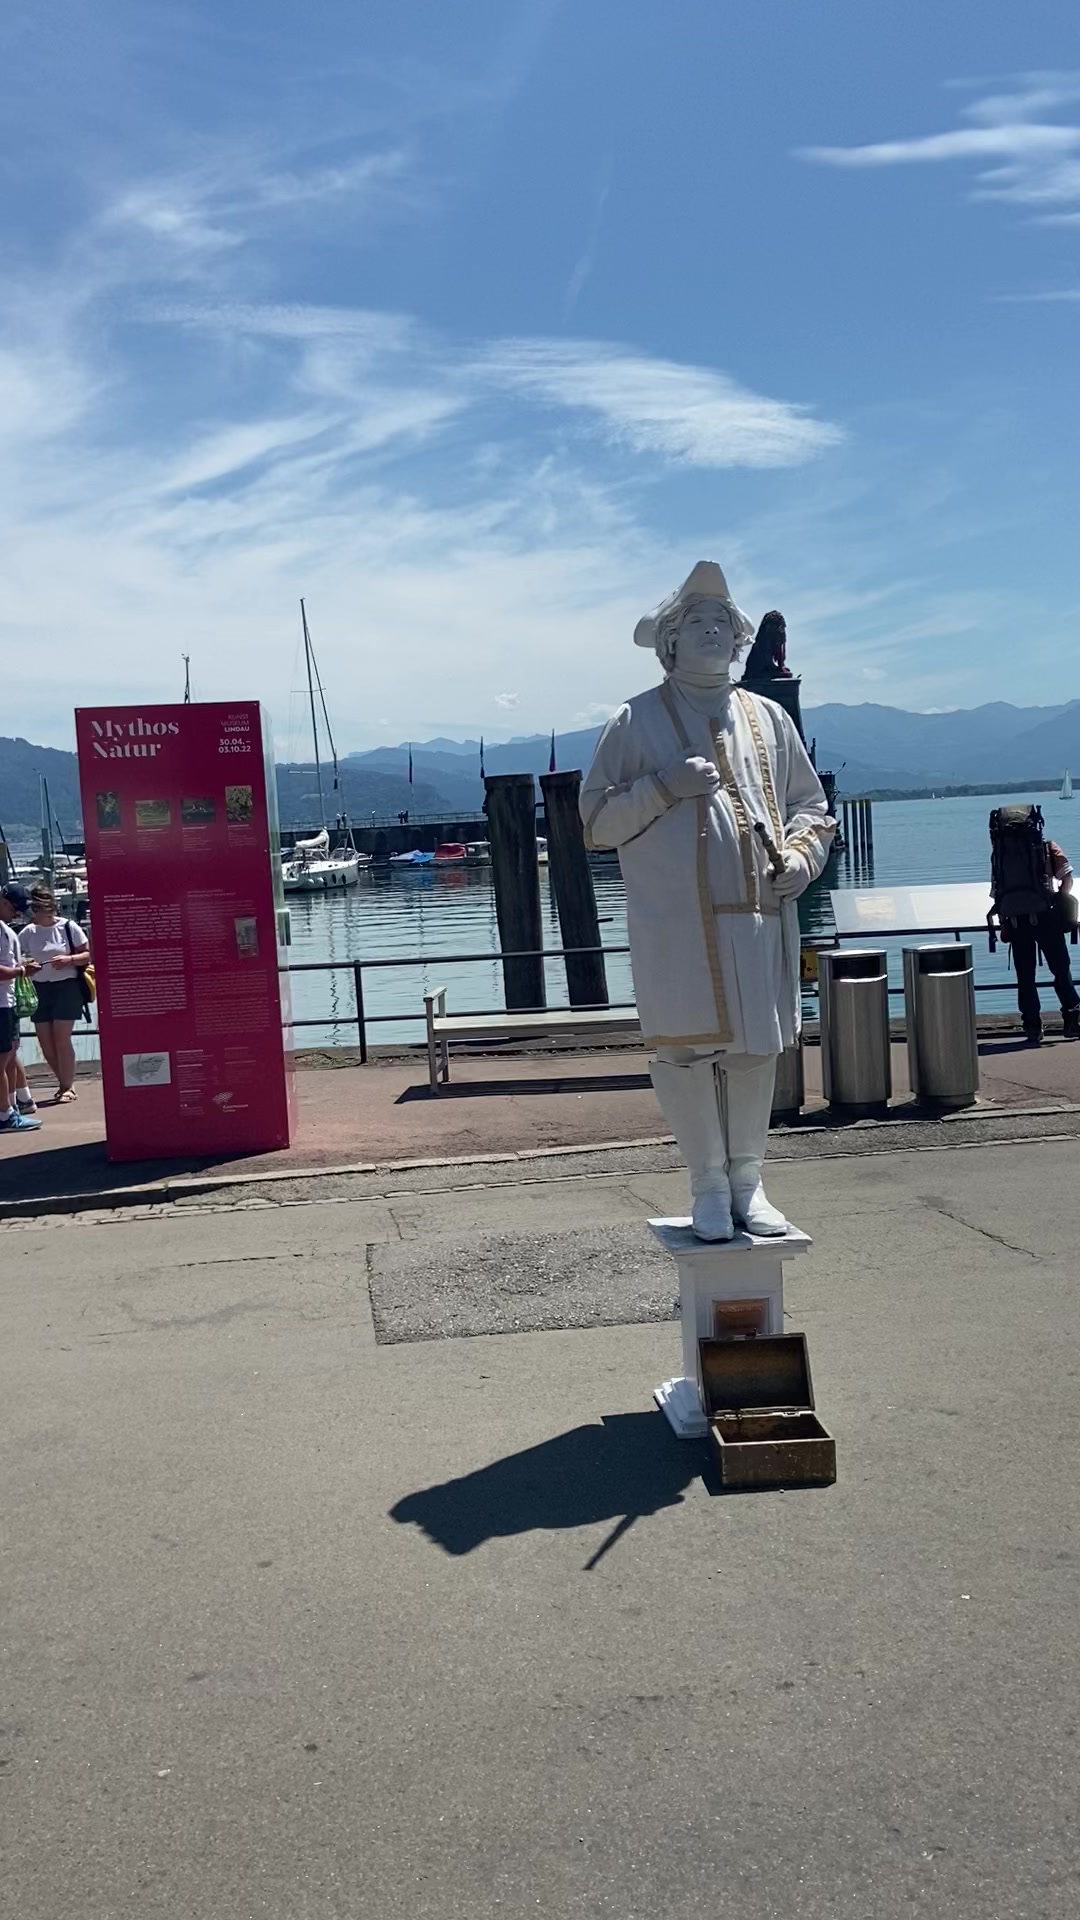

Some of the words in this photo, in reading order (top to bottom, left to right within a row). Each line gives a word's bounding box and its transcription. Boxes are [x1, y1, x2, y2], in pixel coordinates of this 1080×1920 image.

[91, 717, 180, 741] Mythos
[92, 741, 161, 759] Natur
[218, 745, 251, 754] 03.10.22
